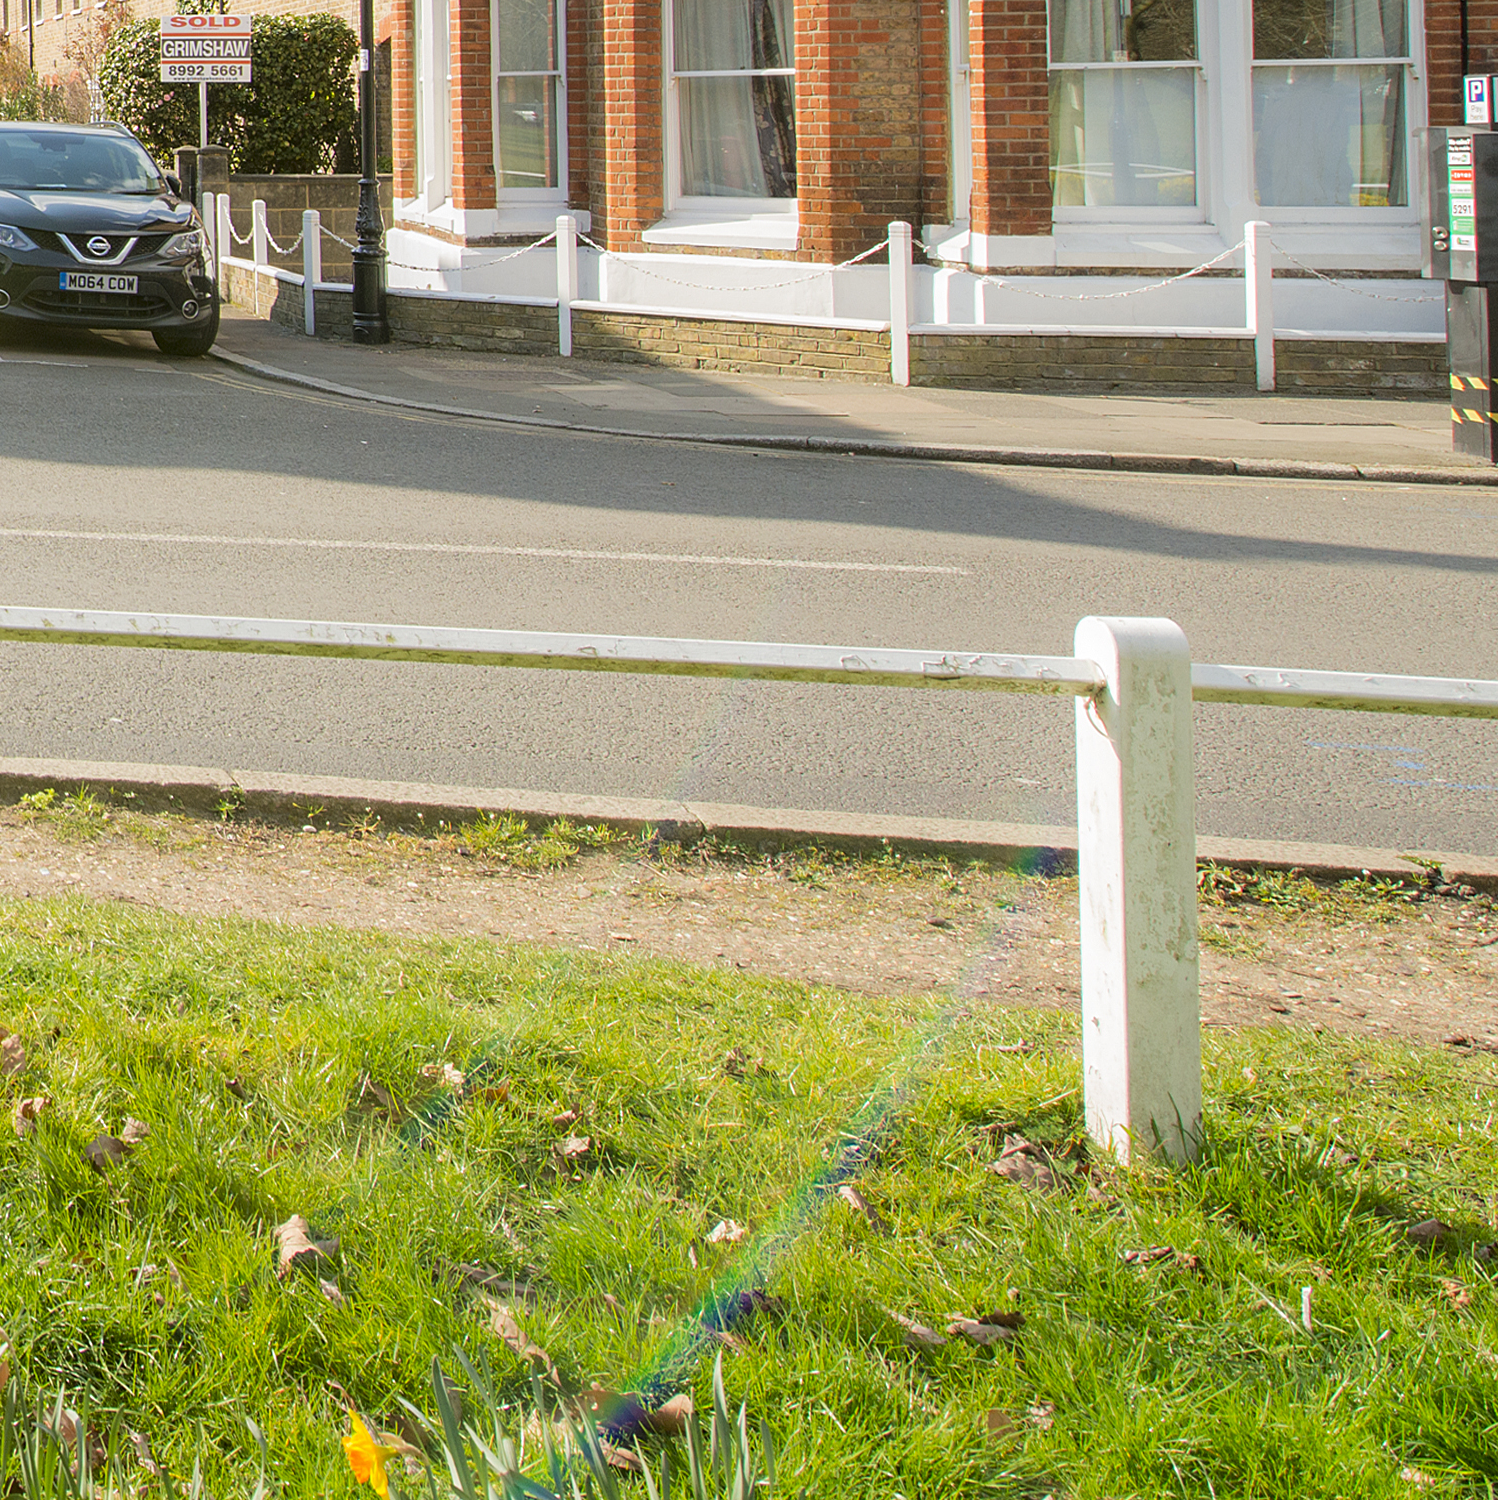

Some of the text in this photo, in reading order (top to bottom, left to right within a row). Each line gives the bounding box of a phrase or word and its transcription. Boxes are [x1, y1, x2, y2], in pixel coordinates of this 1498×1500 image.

[170, 16, 241, 28] SOLD
[163, 40, 249, 57] GRIMSHAW
[169, 65, 243, 76] 8992 5661
[1471, 81, 1483, 102] P
[1453, 204, 1472, 214] 5291
[108, 276, 135, 291] COW
